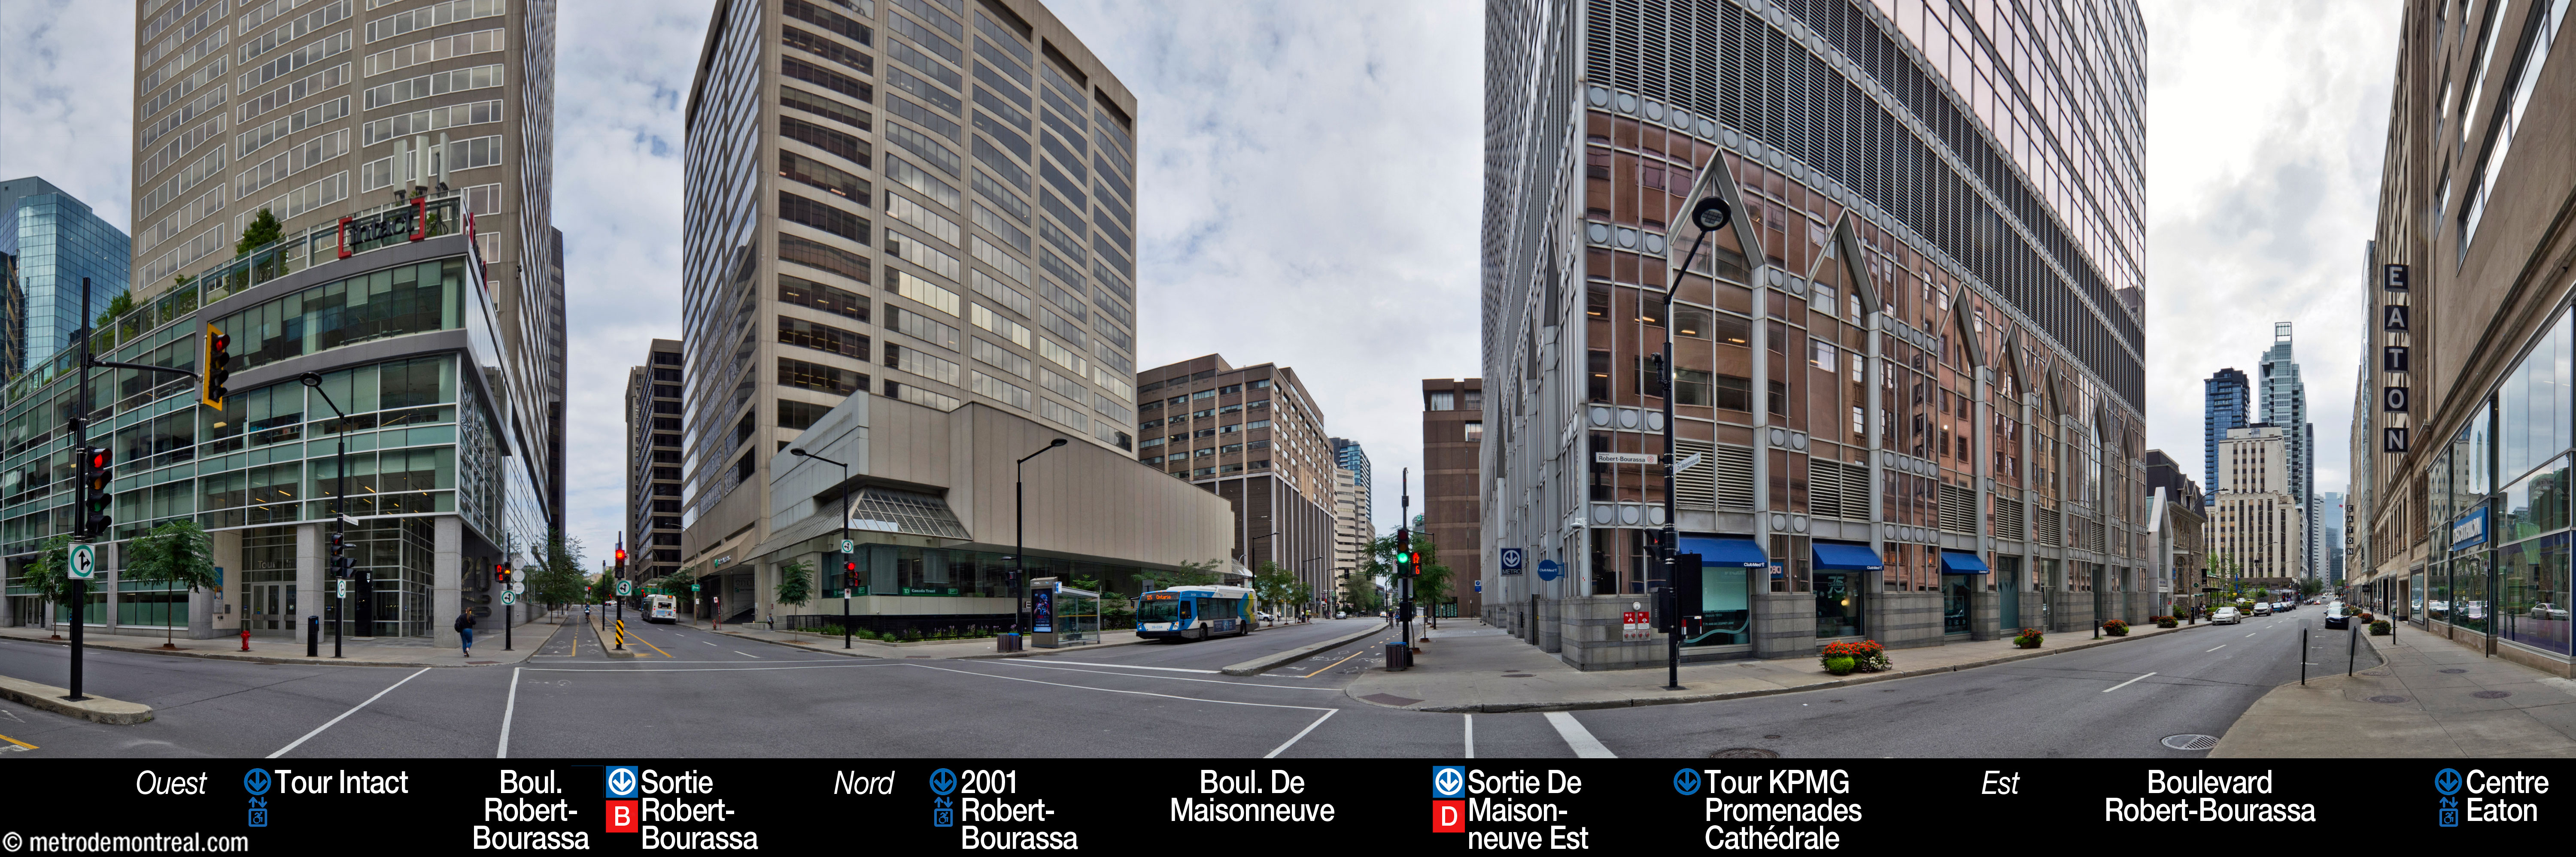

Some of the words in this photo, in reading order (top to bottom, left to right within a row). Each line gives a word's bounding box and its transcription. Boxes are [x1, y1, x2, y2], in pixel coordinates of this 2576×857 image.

[349, 208, 414, 244] intact
[2388, 267, 2405, 449] EATON
[1681, 457, 1699, 469] Maisonneuve
[2453, 516, 2482, 544] DECATHLON
[1416, 566, 1420, 574] 6
[1828, 576, 1845, 593] 75
